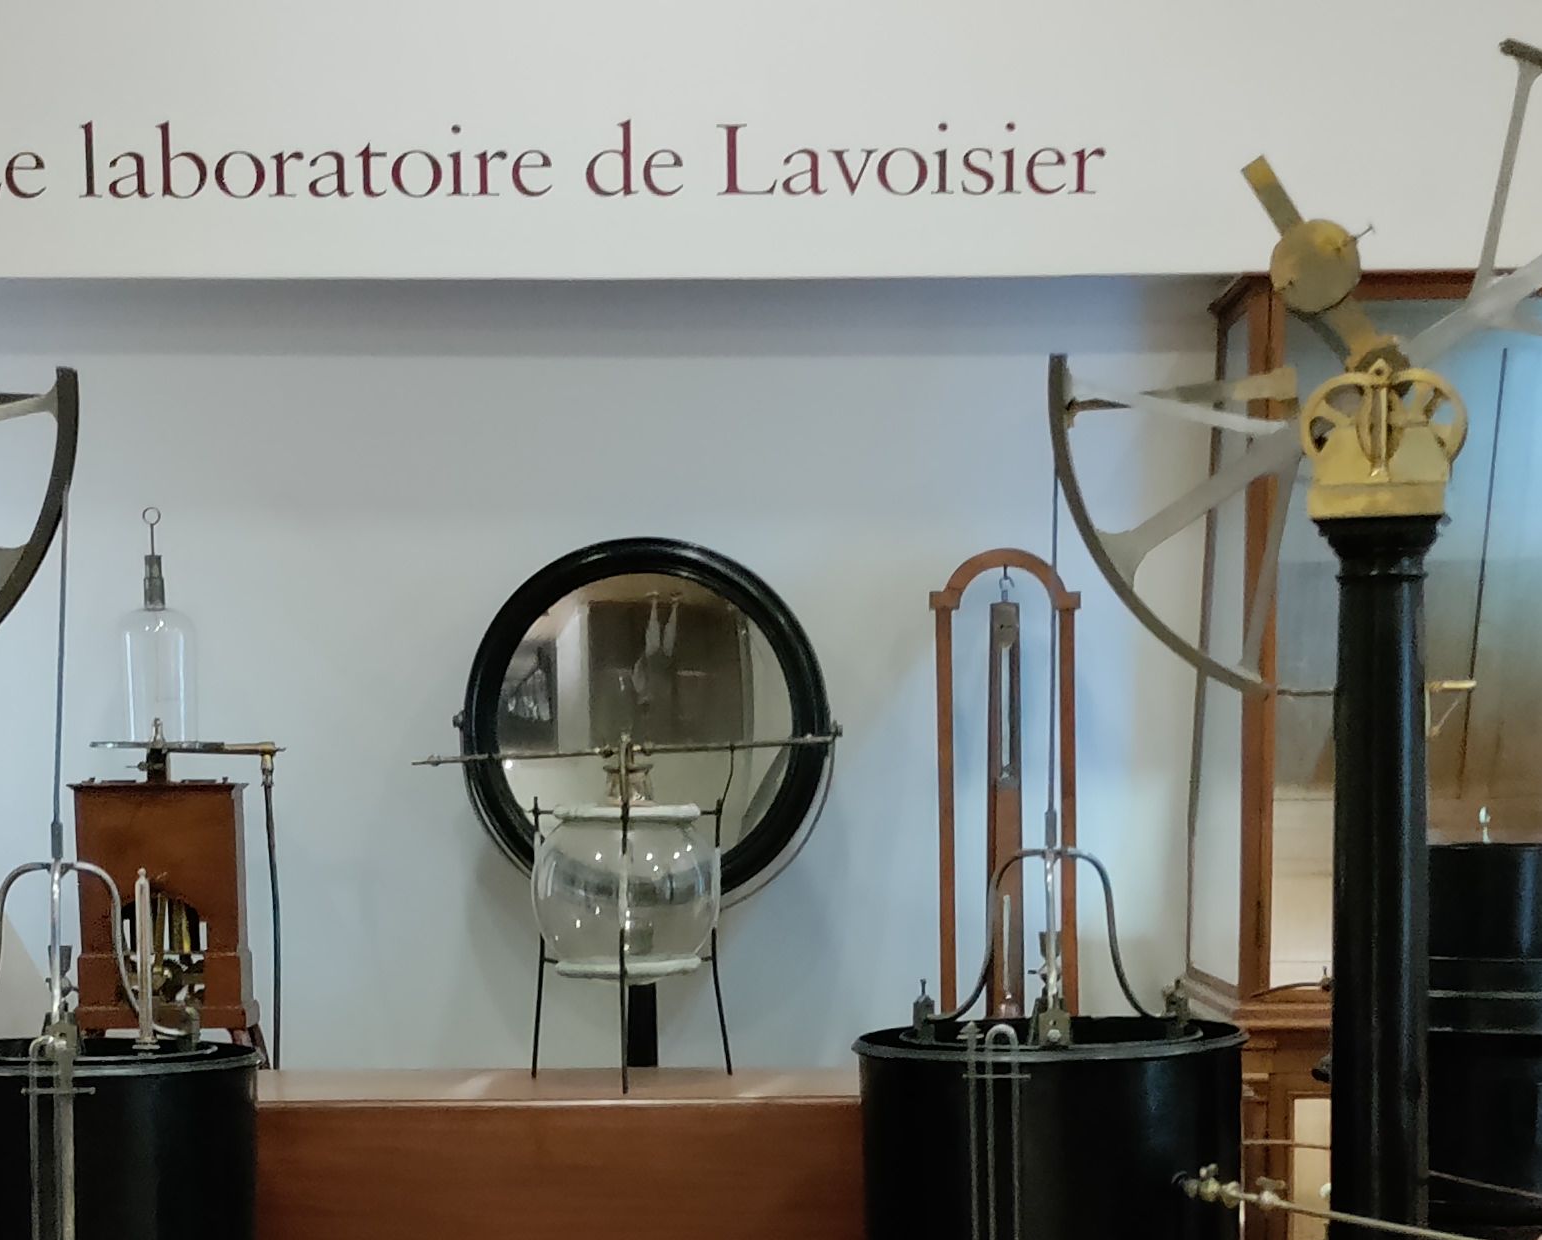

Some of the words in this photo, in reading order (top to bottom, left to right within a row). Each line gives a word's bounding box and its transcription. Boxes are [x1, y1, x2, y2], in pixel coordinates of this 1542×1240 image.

[78, 119, 553, 200] laboratoire
[585, 118, 684, 198] de
[716, 121, 1107, 197] Lavoisier
